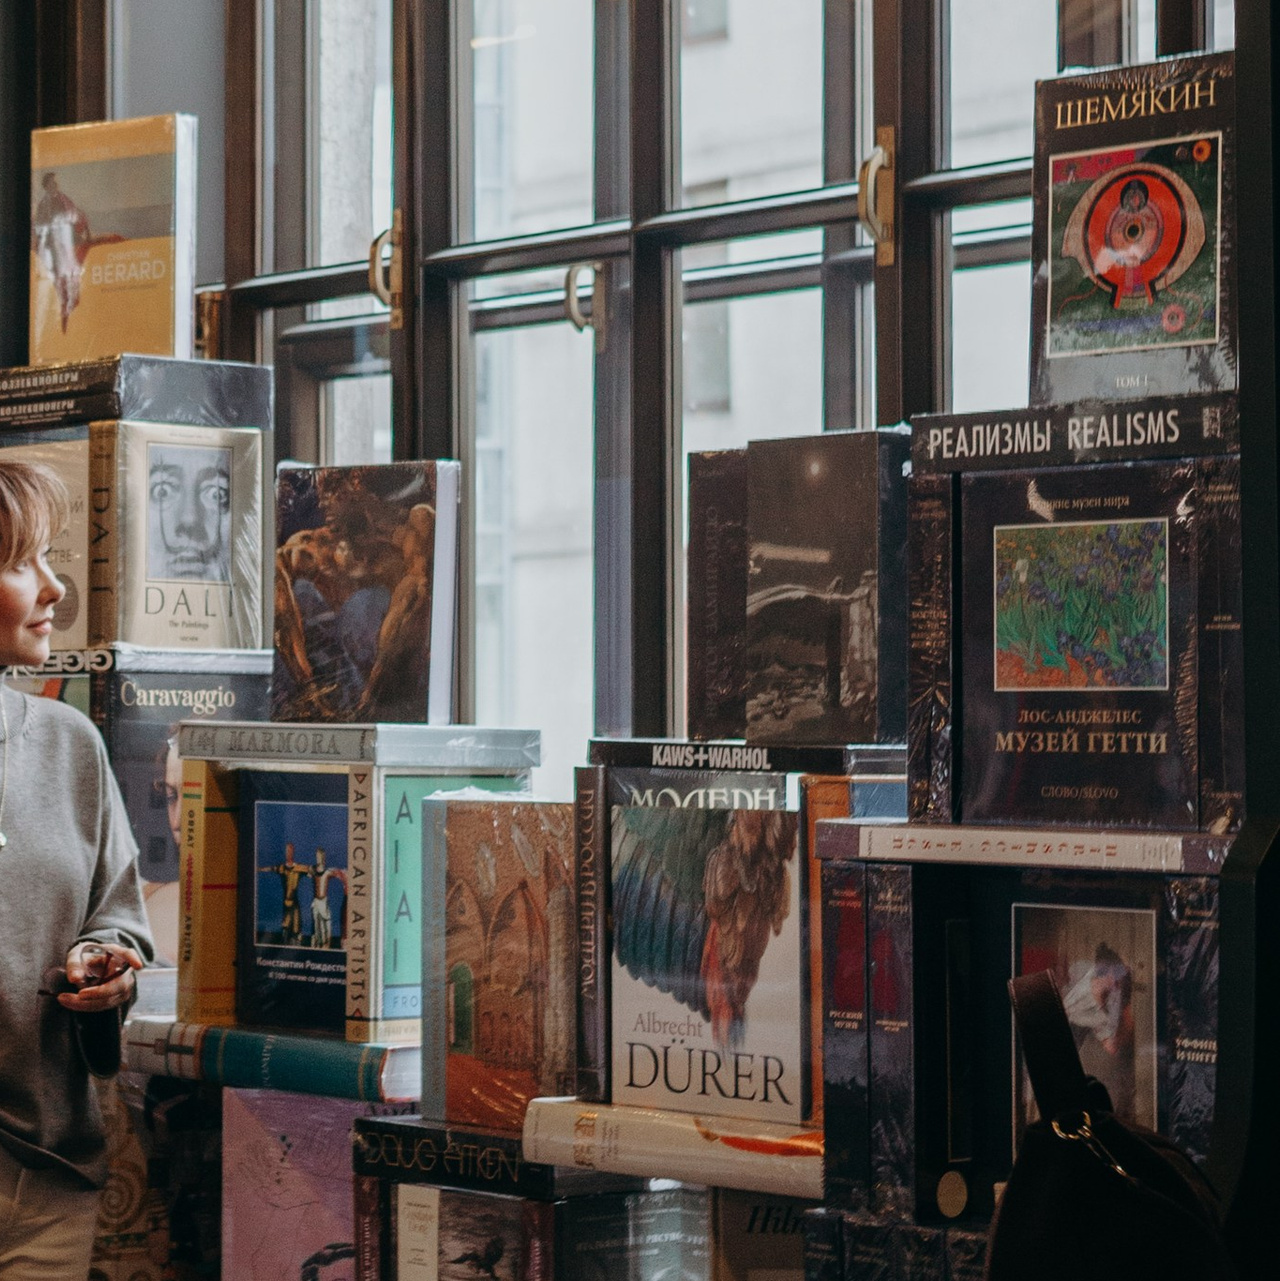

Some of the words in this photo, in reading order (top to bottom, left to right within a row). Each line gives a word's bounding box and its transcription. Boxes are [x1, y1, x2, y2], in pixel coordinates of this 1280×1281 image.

[1056, 79, 1217, 129] ШЕМЯКИН
[91, 260, 165, 286] BERARD
[928, 421, 1052, 459] РЕАЛИЗМЫ
[1067, 409, 1181, 450] REALISMS
[121, 681, 236, 715] Caravaggio
[1018, 709, 1142, 726] ЛОС-АНДЖЕЛЕС
[228, 730, 342, 756] MARMORA
[994, 727, 1080, 753] МУЗЕЙ
[1086, 731, 1168, 754] ГЕТТИ
[651, 745, 772, 770] KAWS+WARHOL
[1041, 785, 1119, 801] СЛОВО/SLOVO
[351, 789, 367, 897] AFRICAN
[256, 956, 304, 970] Константин
[350, 910, 366, 1001] ARTISTS
[633, 1011, 704, 1039] Albrecht
[625, 1037, 794, 1106] DÜRER
